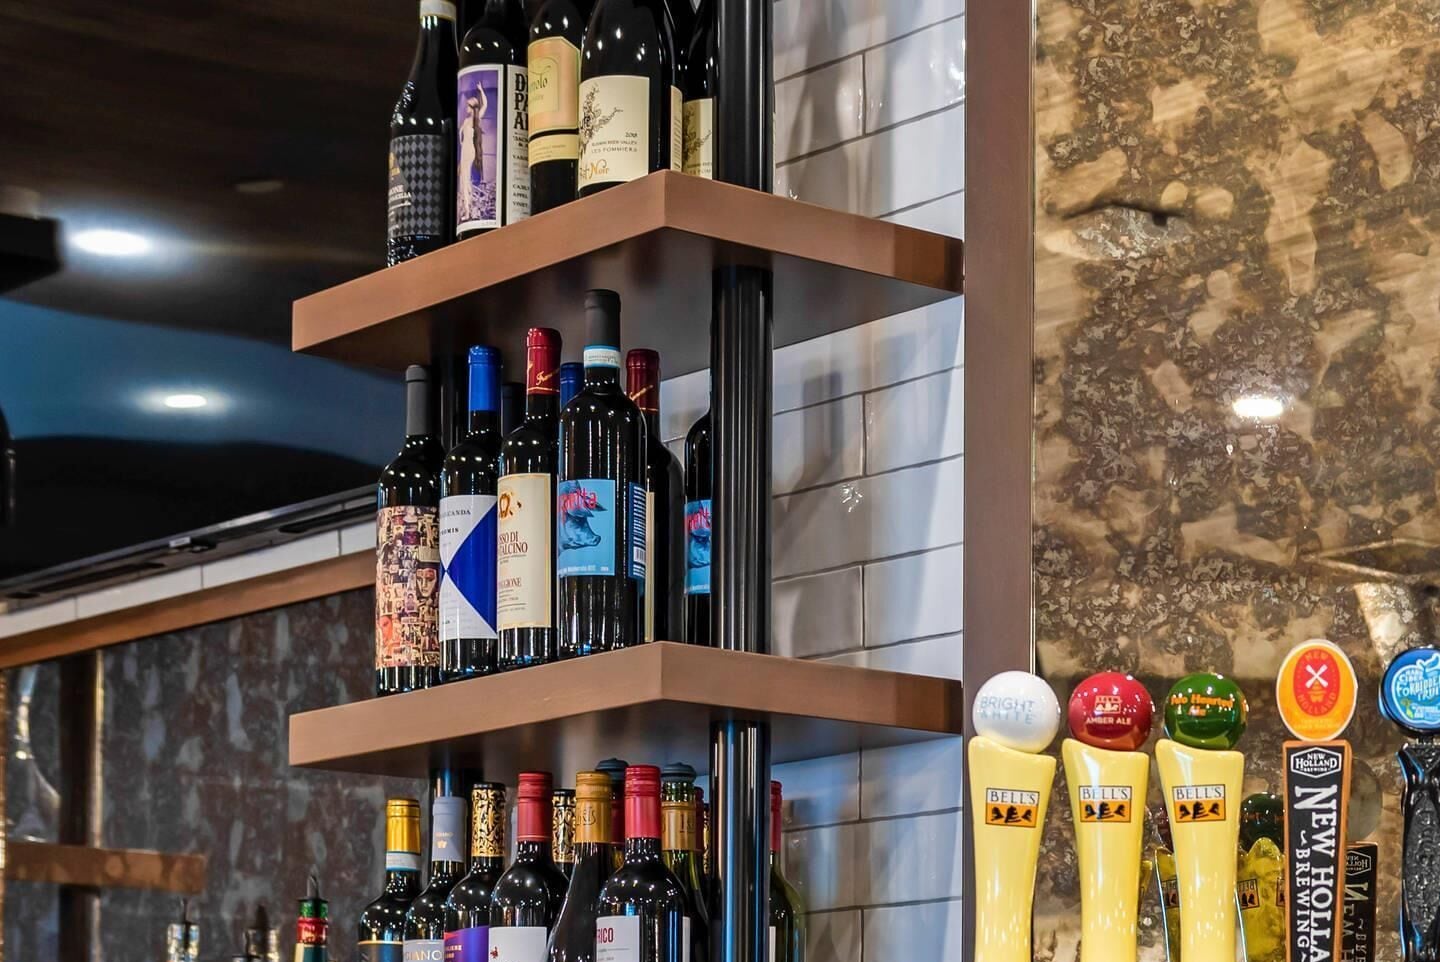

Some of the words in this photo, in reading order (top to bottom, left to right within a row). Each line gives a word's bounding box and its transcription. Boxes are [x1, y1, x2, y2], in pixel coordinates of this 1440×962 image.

[980, 695, 1036, 713] BRIGHT
[980, 709, 1036, 725] WHITE
[1085, 717, 1115, 726] AMBER
[1116, 717, 1132, 726] ALE
[1306, 752, 1326, 761] NEW
[1295, 758, 1338, 770] HOLLAND
[990, 790, 1037, 805] BELL'S
[1082, 787, 1129, 800] BELL'S
[1175, 786, 1223, 800] BELL'S
[1293, 784, 1338, 857] NEW
[1295, 848, 1311, 948] BREWING
